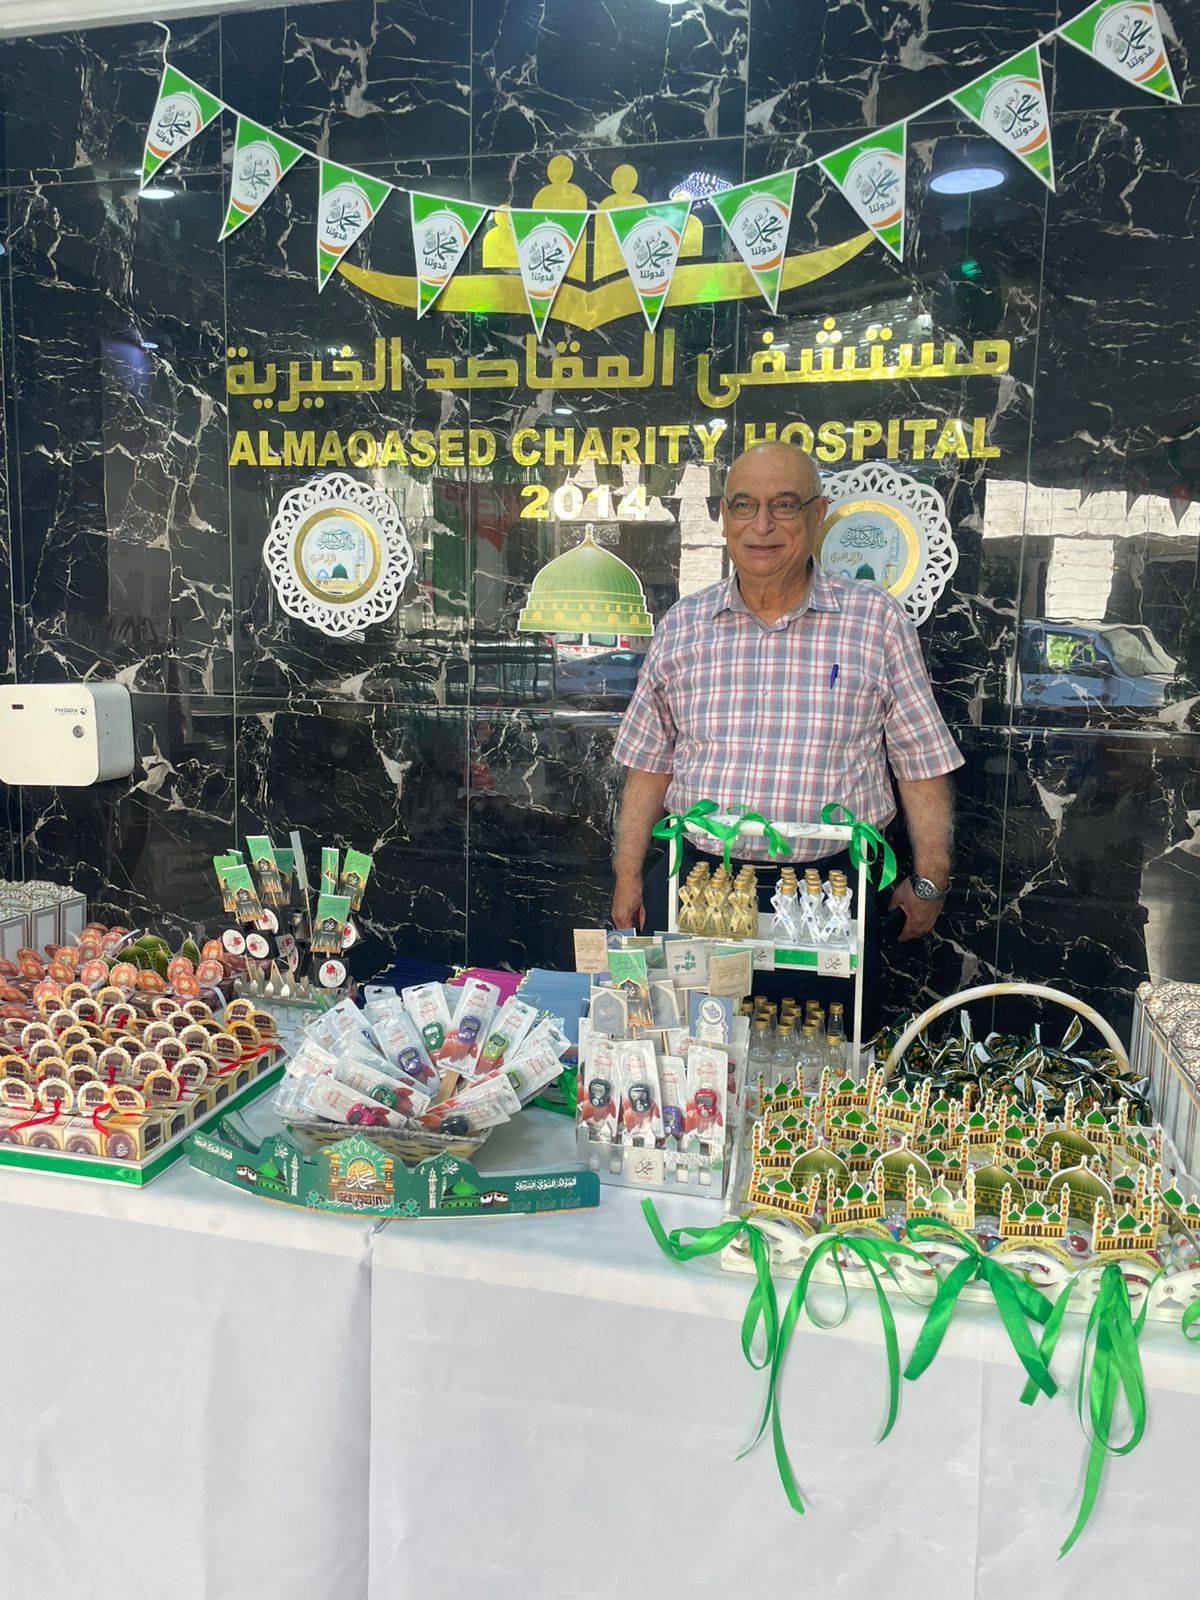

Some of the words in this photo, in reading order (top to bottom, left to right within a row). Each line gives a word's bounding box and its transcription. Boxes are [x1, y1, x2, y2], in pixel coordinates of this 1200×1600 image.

[226, 336, 402, 412] الخيرية
[426, 328, 675, 391] المقاصد
[697, 317, 1011, 409] مستشفى
[228, 429, 497, 467] ALMAQASED
[511, 424, 728, 466] CHARITY
[744, 417, 1001, 462] HOSPITAL
[520, 484, 650, 521] 2014
